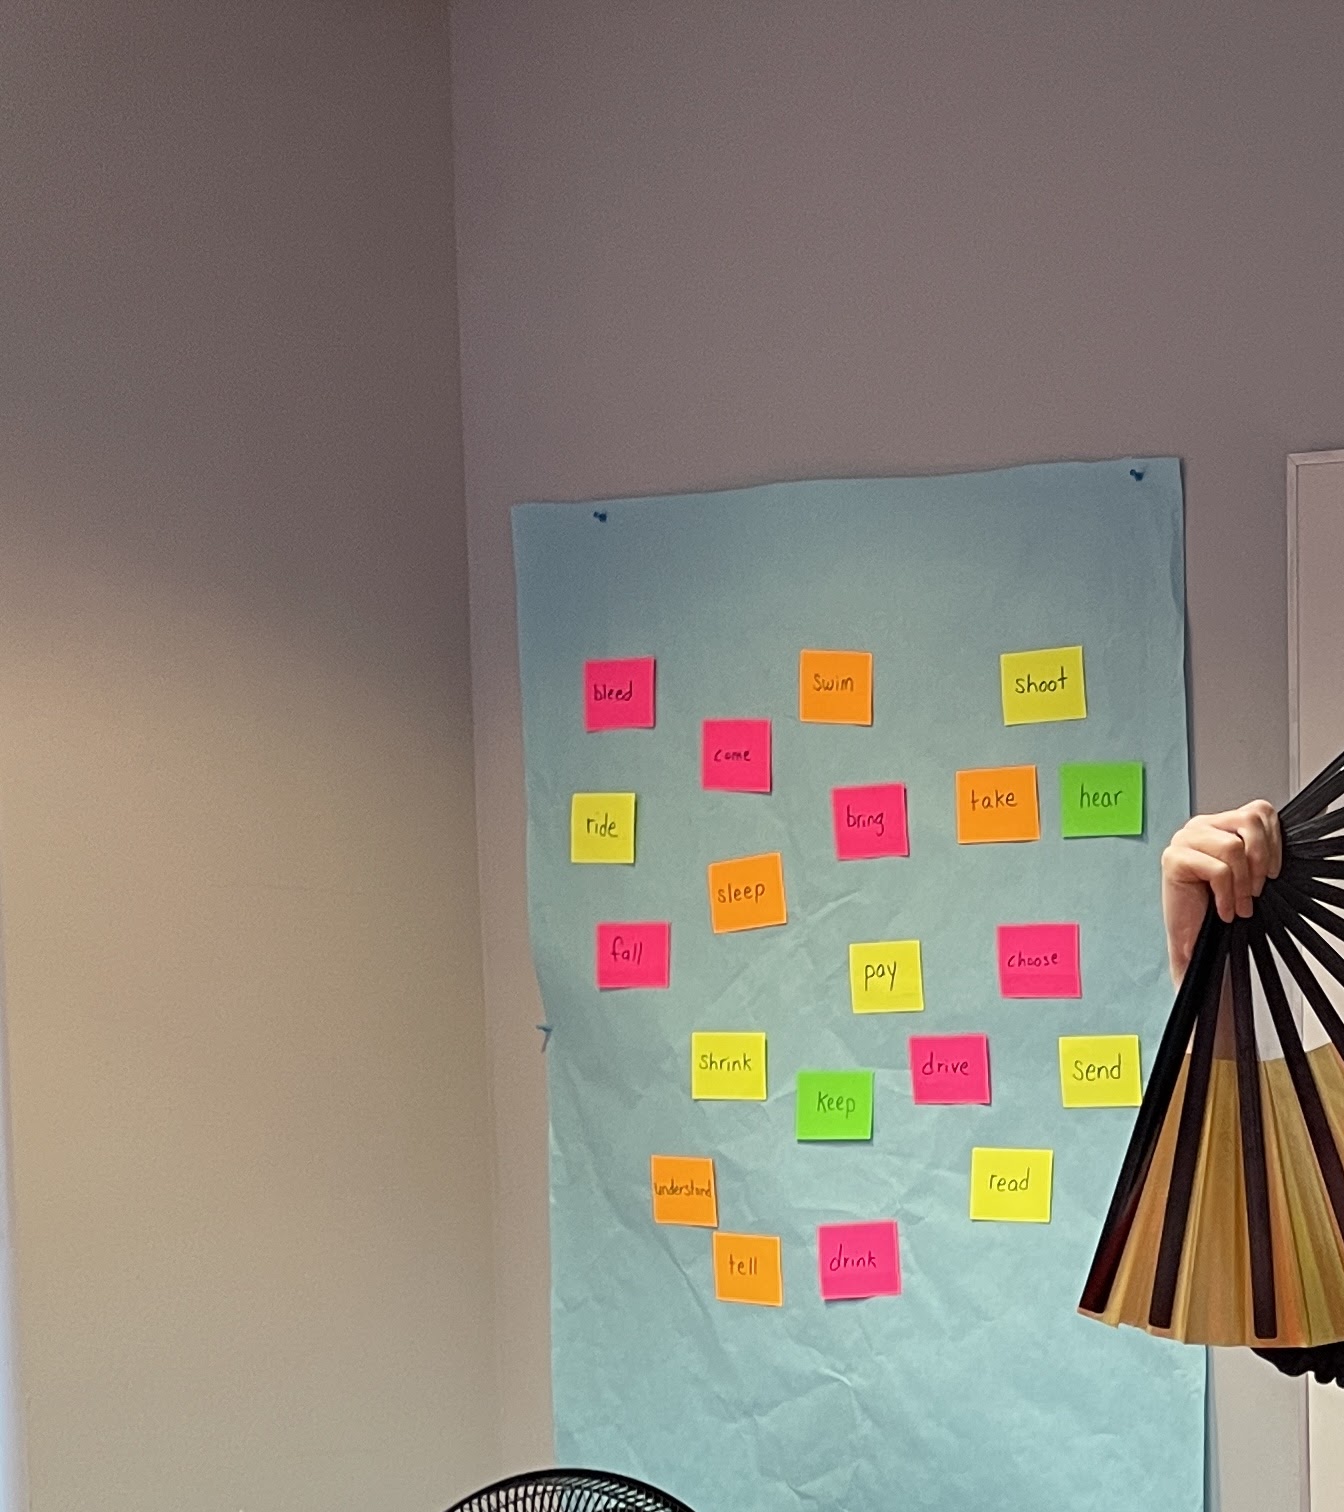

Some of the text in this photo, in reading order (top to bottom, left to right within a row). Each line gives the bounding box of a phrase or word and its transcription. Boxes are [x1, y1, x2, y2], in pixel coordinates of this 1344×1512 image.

[592, 681, 634, 704] bleed
[1014, 672, 1068, 696] shoot
[713, 747, 752, 764] come
[969, 788, 1018, 812] take
[1079, 785, 1124, 809] hear
[585, 813, 618, 838] ride
[845, 810, 886, 836] bring
[716, 879, 767, 905] sleep
[610, 934, 643, 967] fall
[1006, 949, 1059, 969] choose
[863, 960, 898, 992] pay
[921, 1052, 969, 1077] drive
[653, 1176, 713, 1200] understand
[988, 1166, 1031, 1194] read
[727, 1252, 759, 1277] tell
[829, 1245, 878, 1271] drink
